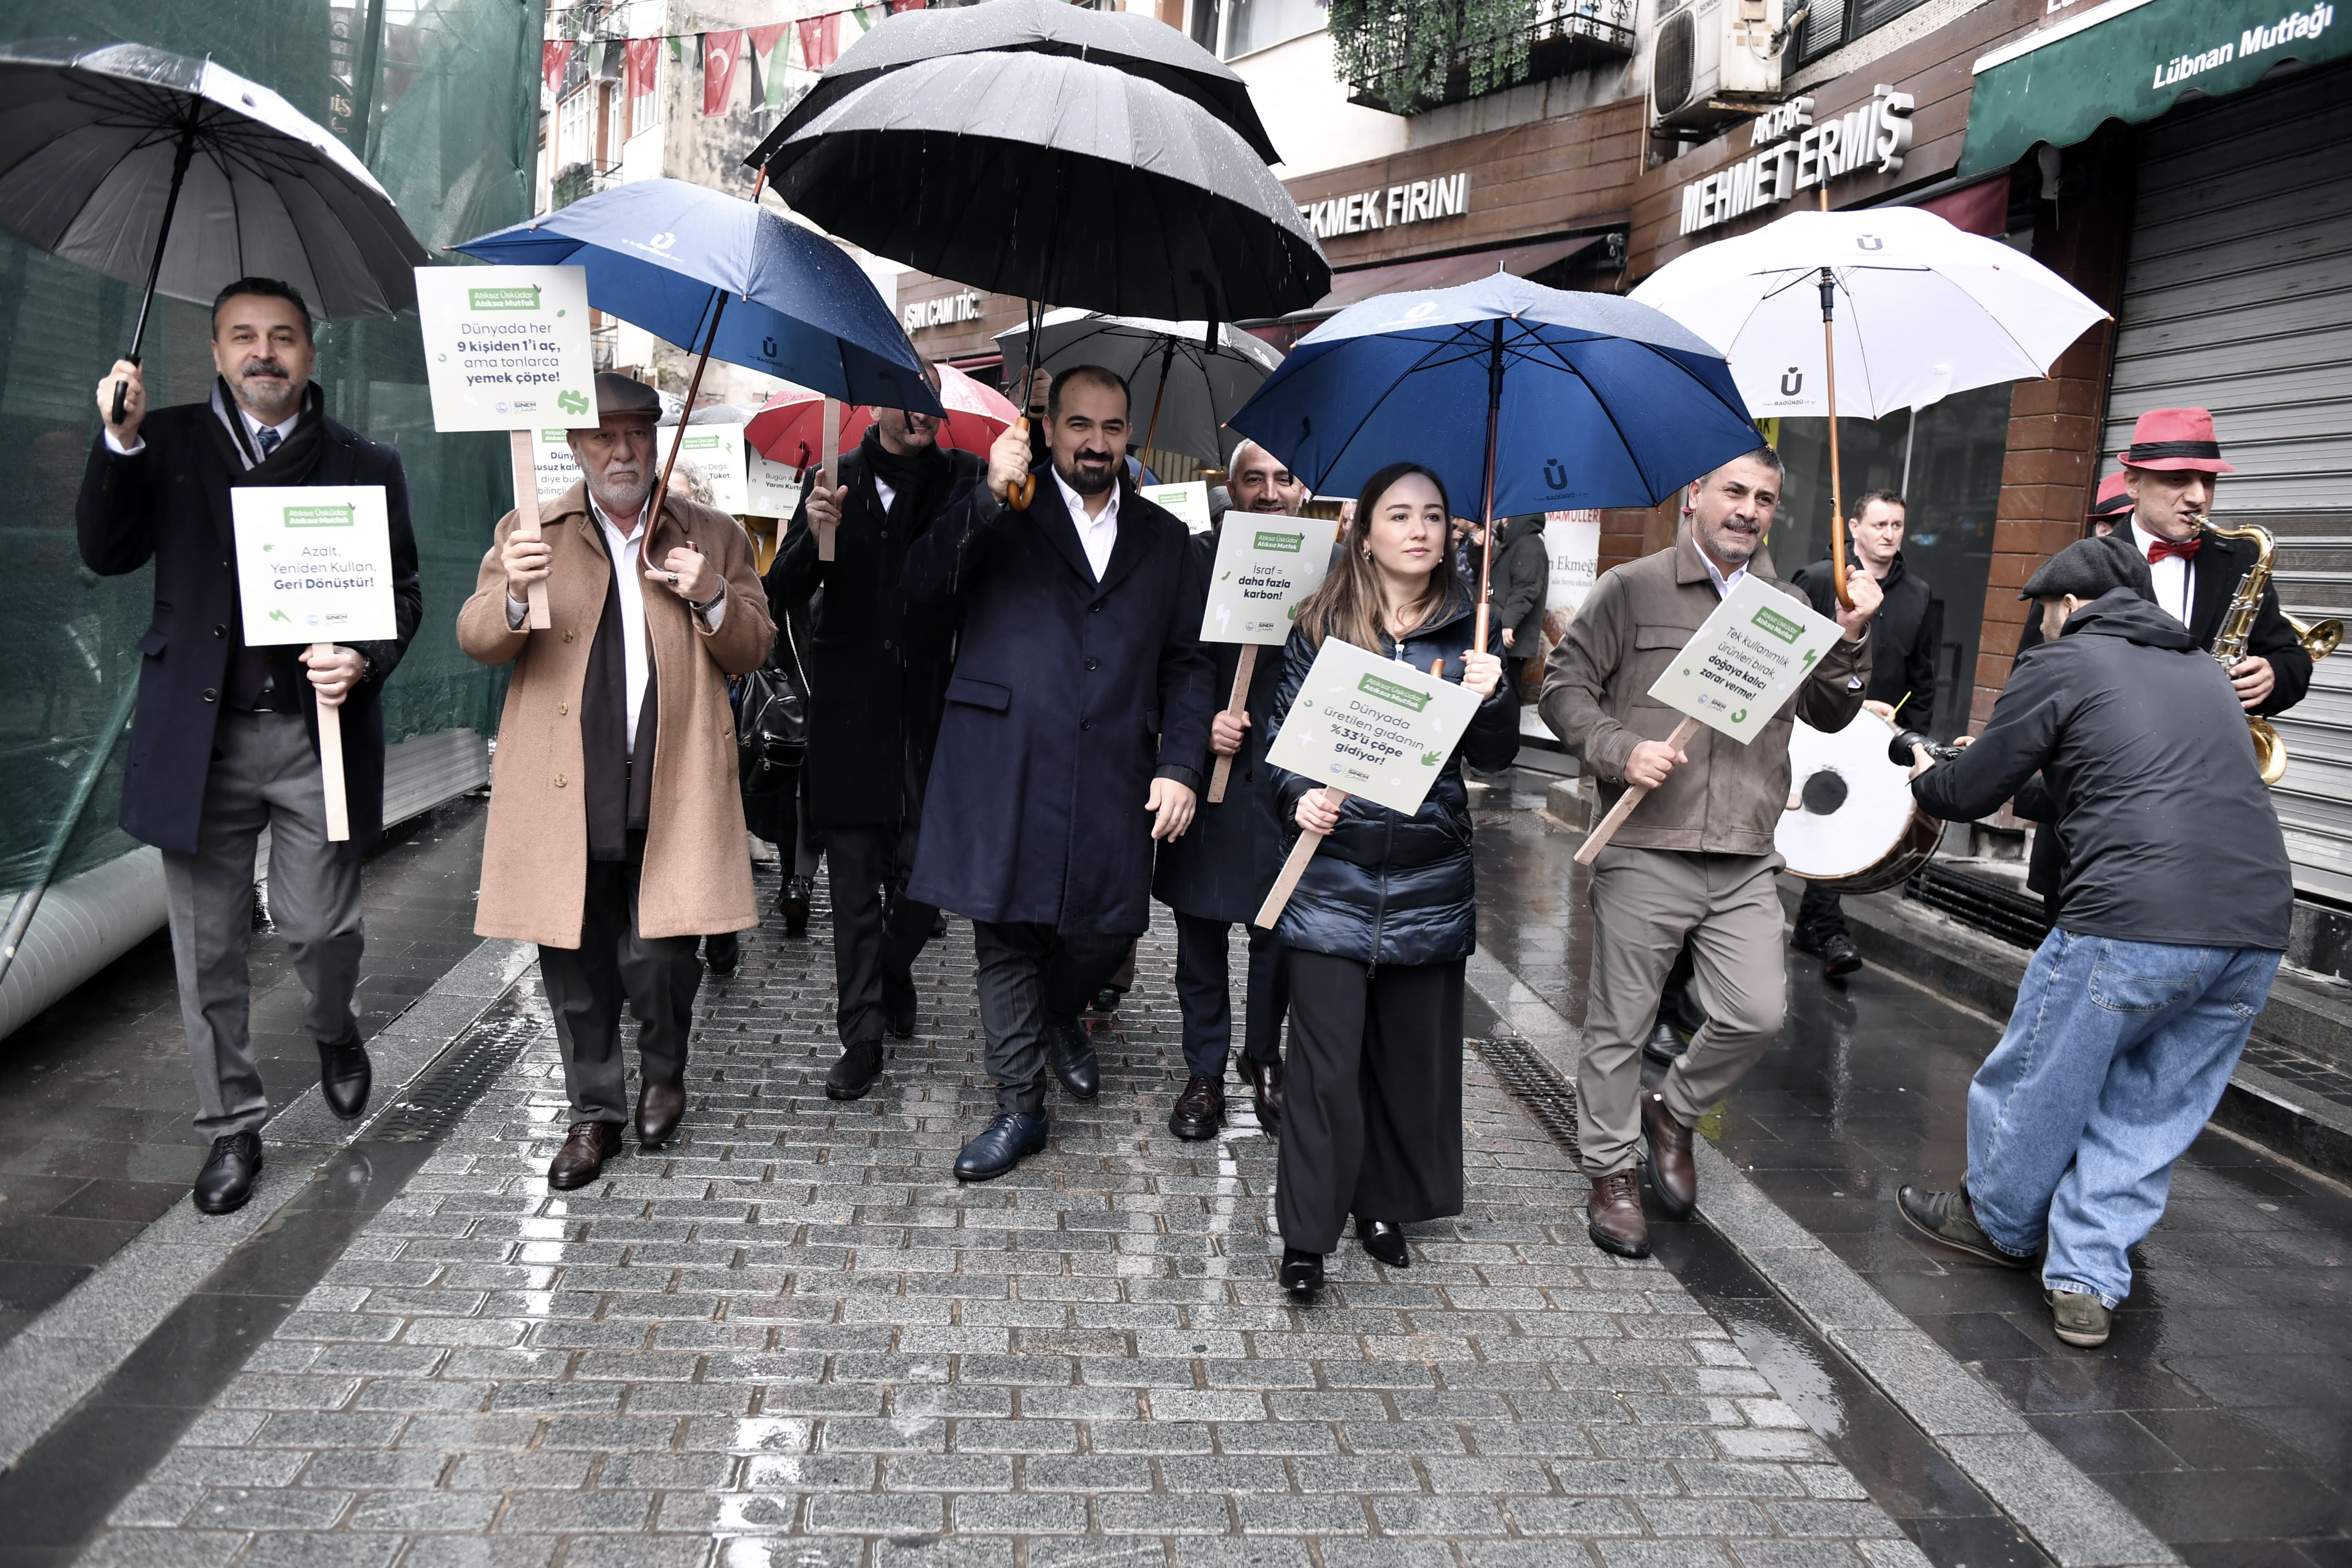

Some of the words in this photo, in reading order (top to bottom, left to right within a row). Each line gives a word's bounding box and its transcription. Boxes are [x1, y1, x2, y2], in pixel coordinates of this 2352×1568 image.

[2153, 43, 2234, 89] Lübnan
[2239, 2, 2334, 58] Mutfağı
[1750, 96, 1814, 147] AKTAR
[1680, 140, 1800, 236] MEHMET
[1795, 83, 1914, 190] ERMİŞ
[1386, 173, 1468, 226] FIRINI
[500, 291, 533, 299] Üsküdar
[904, 302, 926, 335] IŞIN
[929, 297, 953, 326] CAM
[461, 323, 526, 337] Dünyada
[530, 322, 552, 334] her
[457, 342, 466, 352] 9
[469, 340, 520, 354] kişiden
[539, 342, 561, 353] aç,
[464, 359, 497, 368] ama
[501, 356, 558, 368] tonlarca
[466, 372, 513, 386] yemek
[515, 372, 560, 385] çöpte!
[551, 452, 574, 461] Düny
[541, 475, 560, 485] diye
[765, 473, 787, 481] Bugün
[1276, 535, 1298, 543] Üsküdar
[302, 546, 341, 557] Azalt,
[270, 563, 327, 574] Yeniden
[331, 561, 376, 573] Kullan,
[1253, 562, 1276, 575] İsraf
[1557, 555, 1597, 577] Ekmeği
[274, 579, 302, 590] Geri
[306, 577, 374, 589] Dönüştür!
[1239, 576, 1264, 586] daha
[1266, 578, 1291, 588] fazla
[1244, 588, 1283, 600] karbon!
[1727, 626, 1742, 642] Tek
[1742, 635, 1790, 668] kullanımlık
[1718, 641, 1754, 666] ürünleri
[1751, 657, 1776, 681] bırak,
[1708, 654, 1743, 677] doğaya
[1742, 671, 1767, 690] kalıcı
[1699, 668, 1726, 685] zarar
[1725, 681, 1757, 701] verme!
[1349, 700, 1410, 730] Dünyada
[1324, 706, 1372, 731] üretilen
[1373, 727, 1424, 750] gıdanın
[1334, 743, 1386, 765] gidiyor!
[1370, 741, 1403, 757] çöpe
